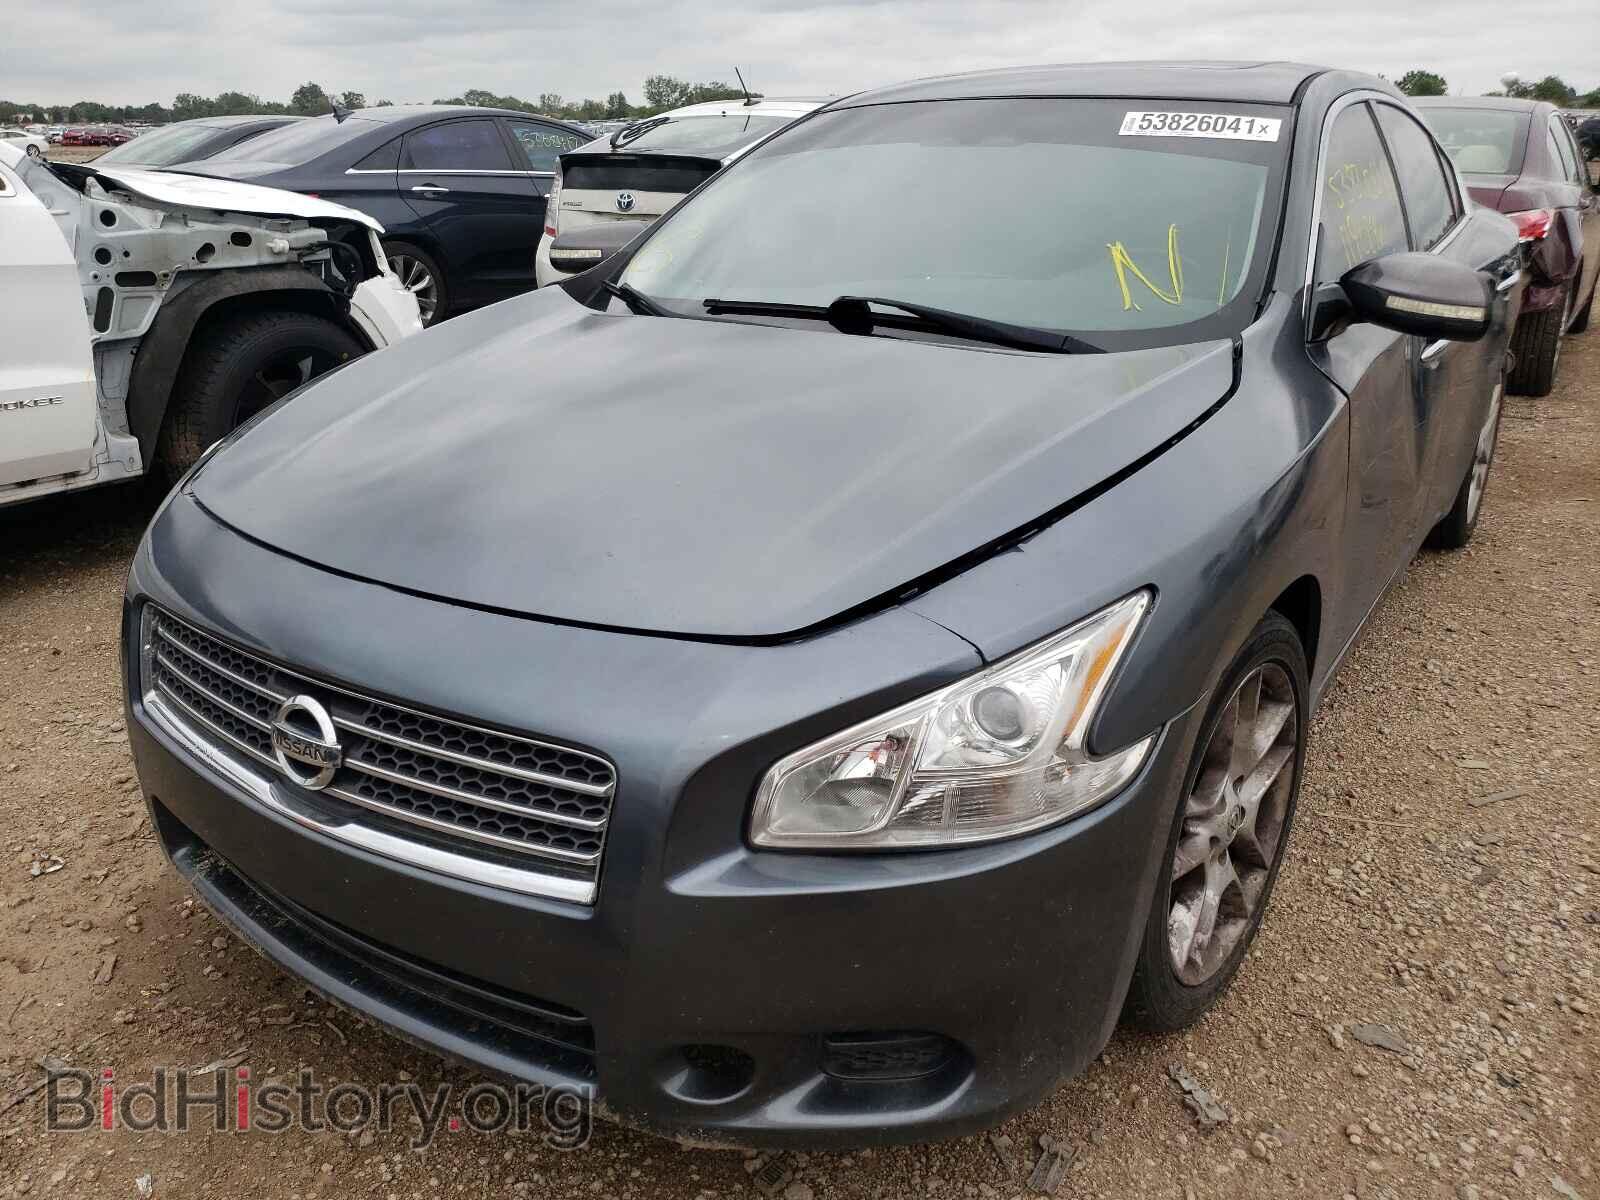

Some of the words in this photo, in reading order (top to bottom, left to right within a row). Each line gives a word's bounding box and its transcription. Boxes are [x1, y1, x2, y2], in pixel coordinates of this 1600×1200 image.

[1106, 223, 1184, 312] N
[0, 395, 64, 411] OKEE
[272, 729, 329, 765] NISSAN
